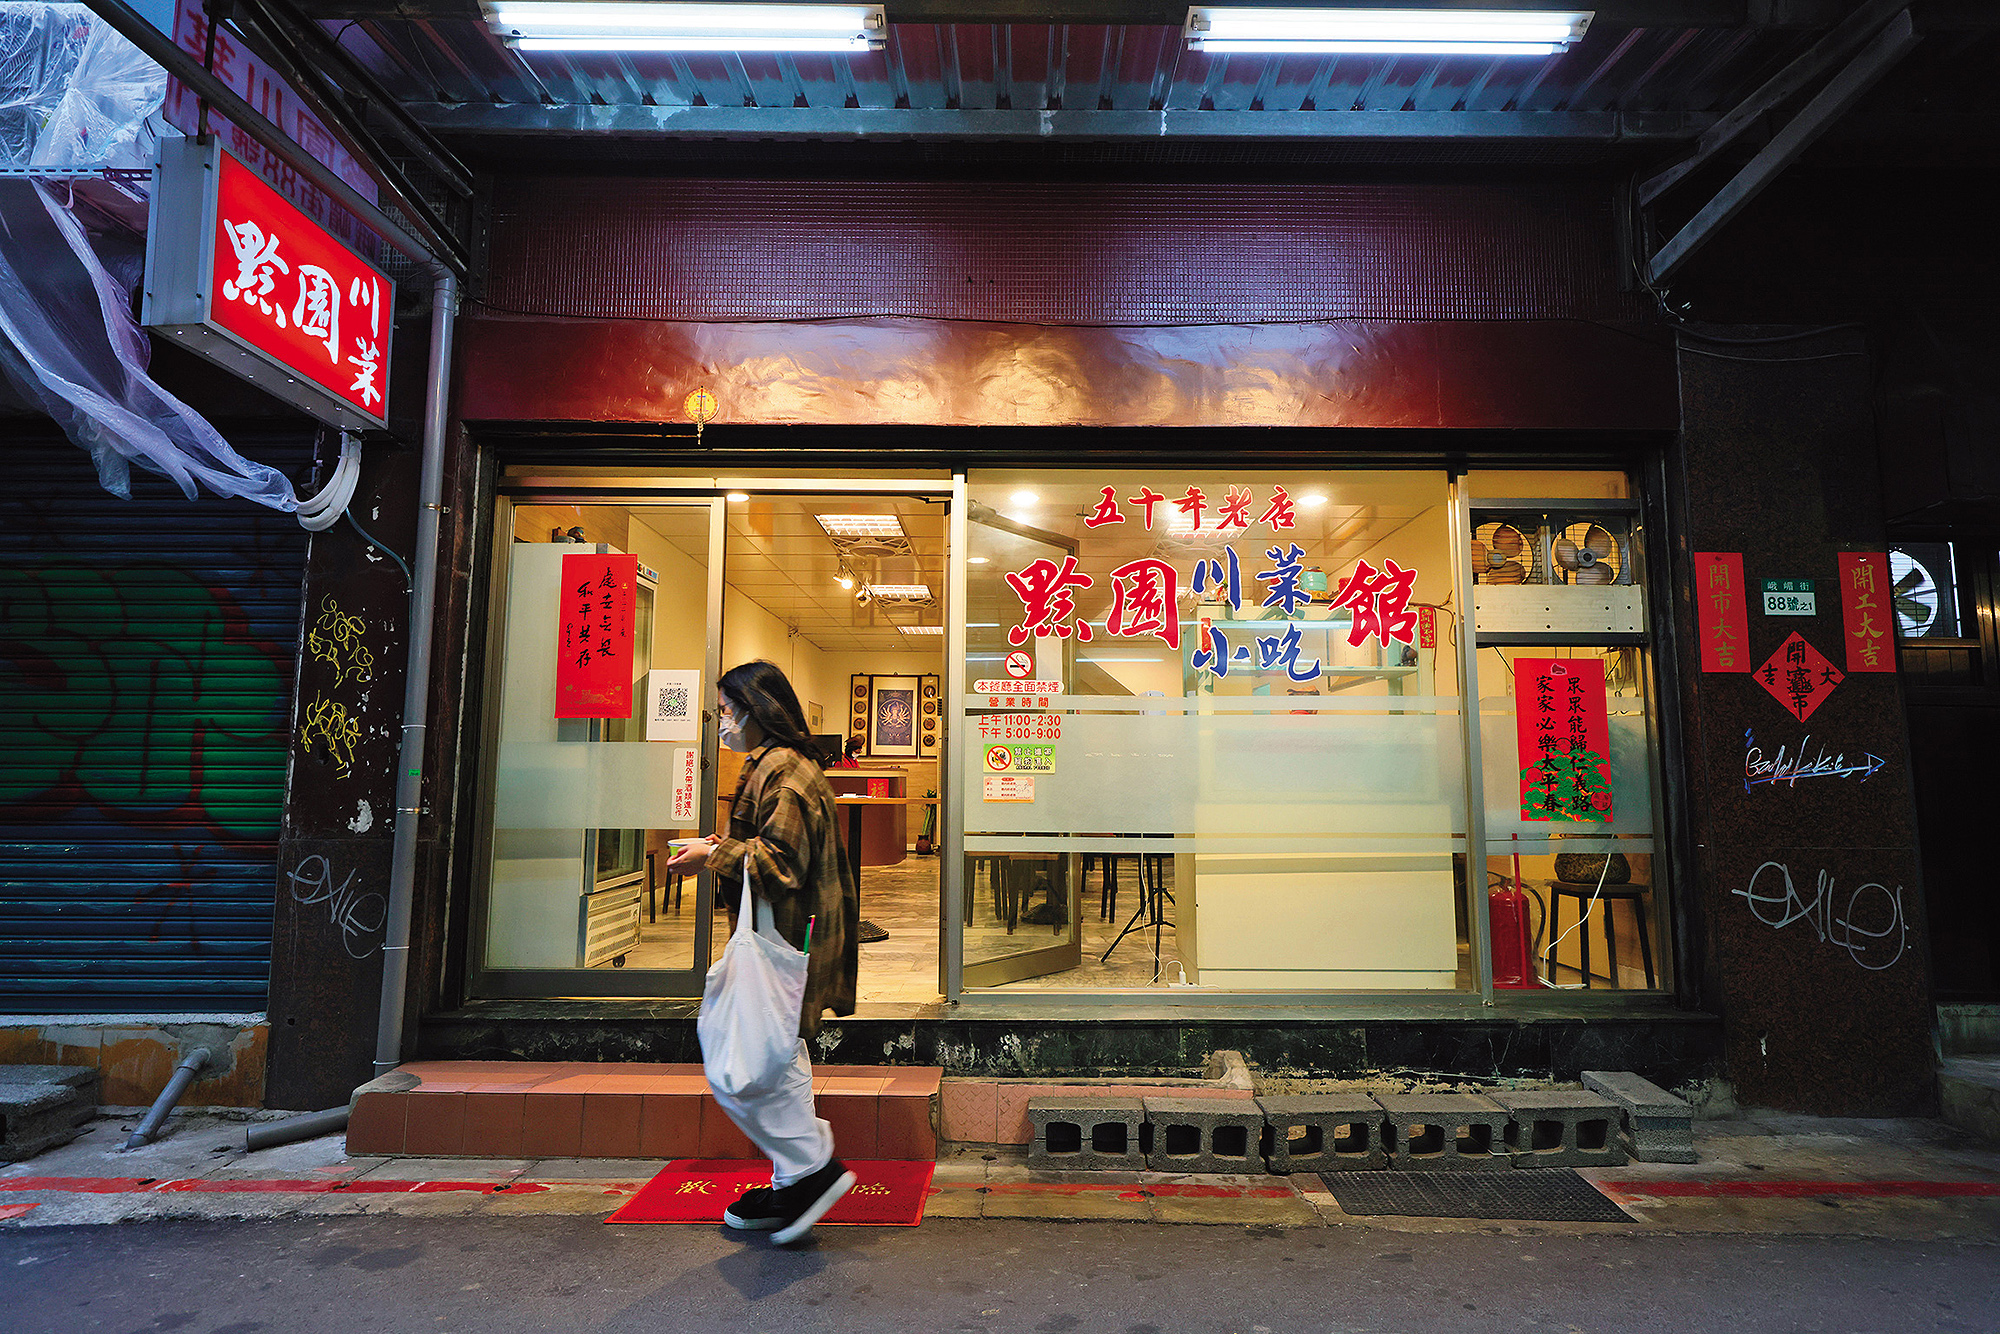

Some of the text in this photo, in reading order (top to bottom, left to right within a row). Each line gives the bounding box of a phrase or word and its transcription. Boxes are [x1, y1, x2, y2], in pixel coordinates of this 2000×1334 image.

[348, 277, 381, 407] 川菜
[1084, 485, 1298, 531] 五十年老店
[1193, 543, 1312, 615] 川菜
[1327, 558, 1418, 649] 館
[1708, 563, 1737, 668] 開市大吉
[1767, 596, 1813, 611] 88號之1
[1850, 563, 1884, 668] 開工大吉
[1190, 622, 1322, 682] 小吃
[978, 714, 1001, 726] 上午
[988, 696, 1049, 708] 營業時間
[978, 727, 1001, 739] 下午
[1536, 675, 1563, 812] 家家必樂太平春
